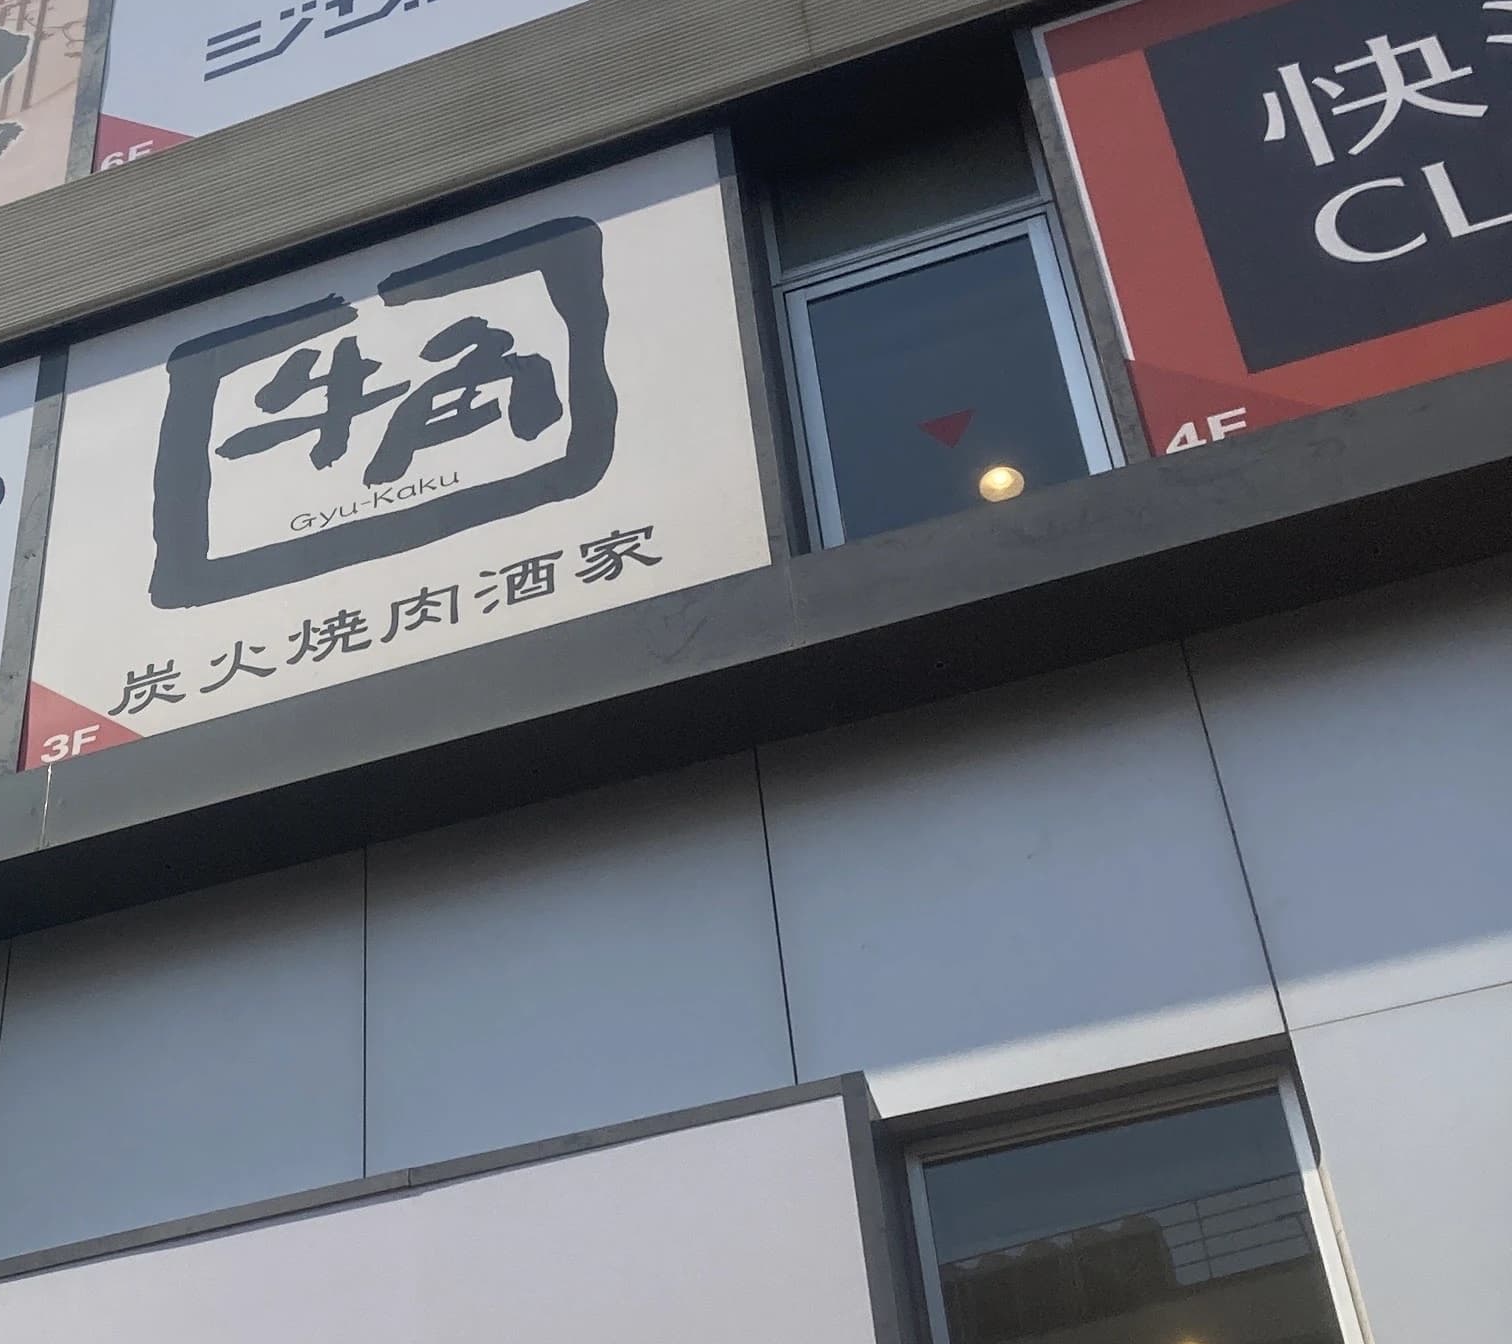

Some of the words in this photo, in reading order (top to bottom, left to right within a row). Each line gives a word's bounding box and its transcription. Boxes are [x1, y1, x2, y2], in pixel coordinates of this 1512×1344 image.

[100, 140, 153, 171] 6F
[215, 316, 563, 488] 牛角
[1166, 408, 1247, 454] 4F
[289, 469, 460, 533] Gyu-Kaku
[108, 525, 663, 717] 炭火焼肉酒家
[41, 724, 100, 763] 3F
